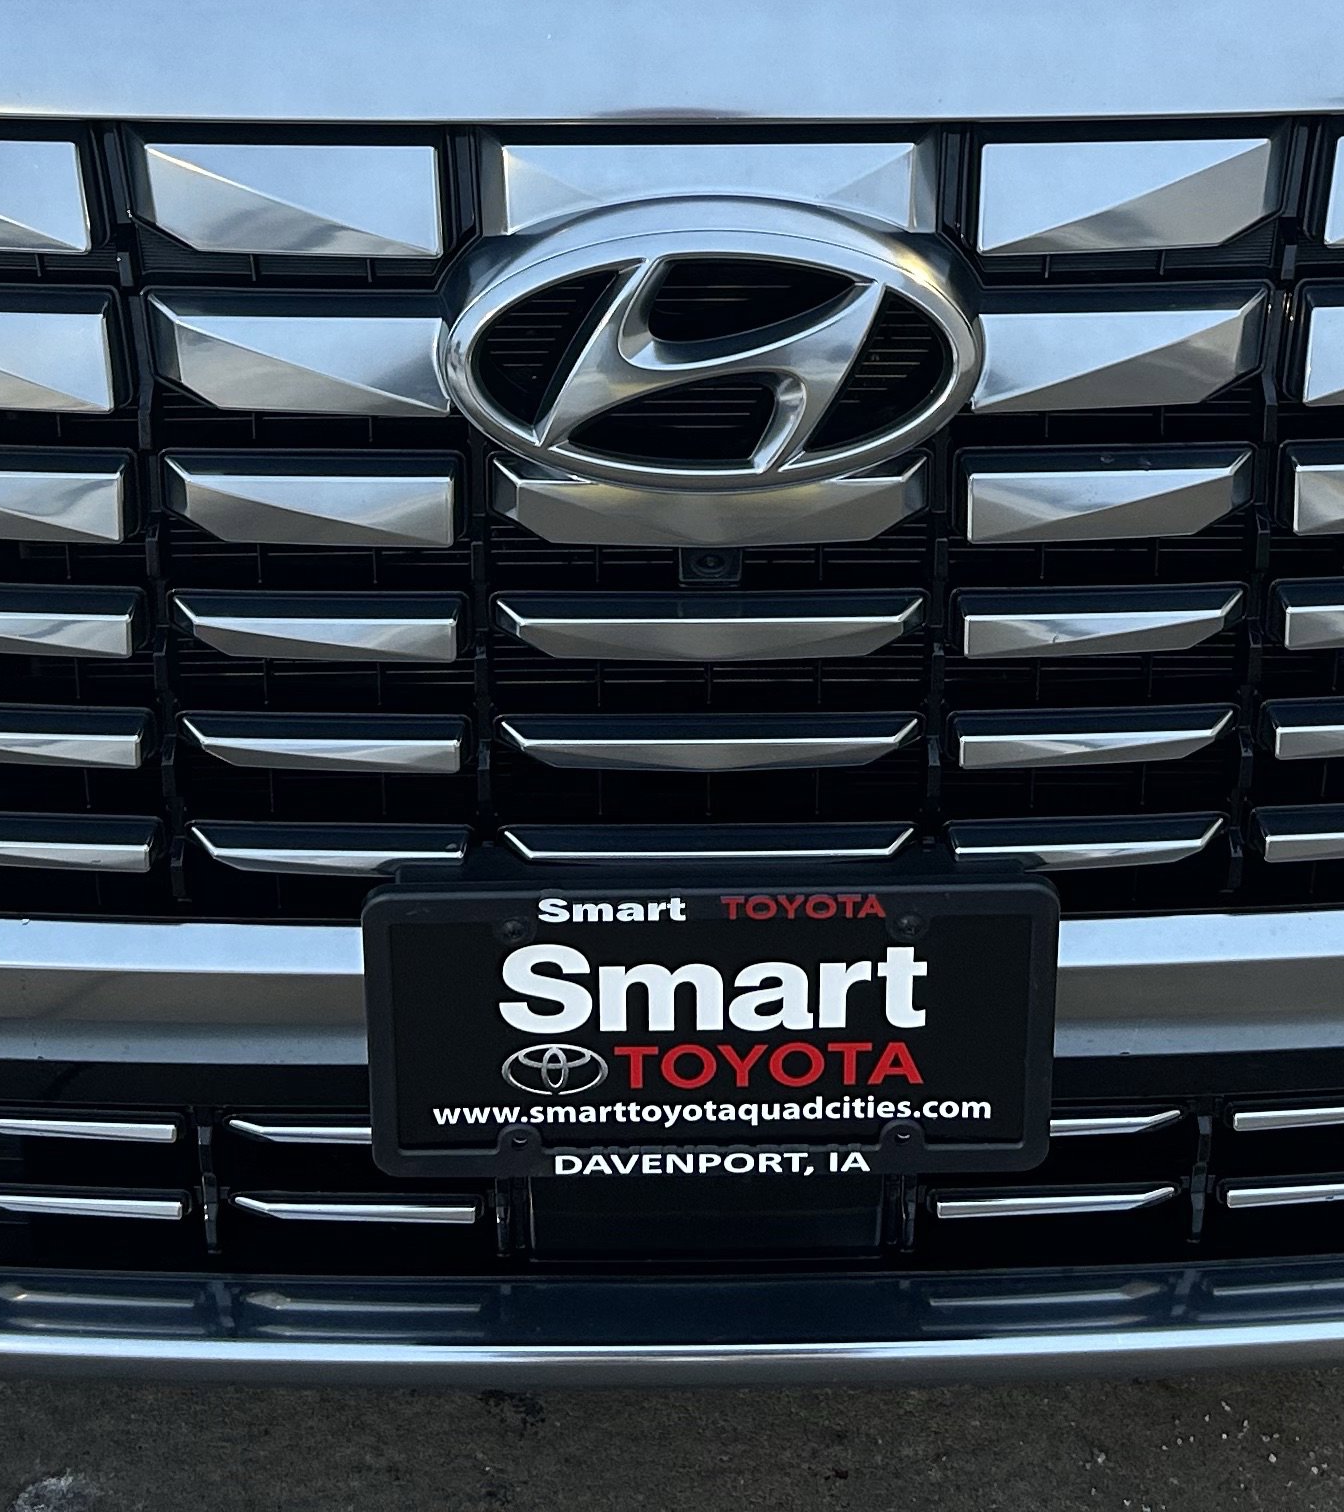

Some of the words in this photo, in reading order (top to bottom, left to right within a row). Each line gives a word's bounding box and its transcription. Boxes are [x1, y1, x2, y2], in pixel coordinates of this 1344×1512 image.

[538, 897, 687, 923] Smart
[721, 894, 886, 920] TOYOTA
[498, 943, 928, 1034] Smart
[614, 1041, 924, 1089] TOYOTA
[433, 1095, 993, 1128] www.smarttoyotaquadcities.com
[554, 1152, 815, 1177] DAVENPORT,
[828, 1151, 871, 1174] IA
